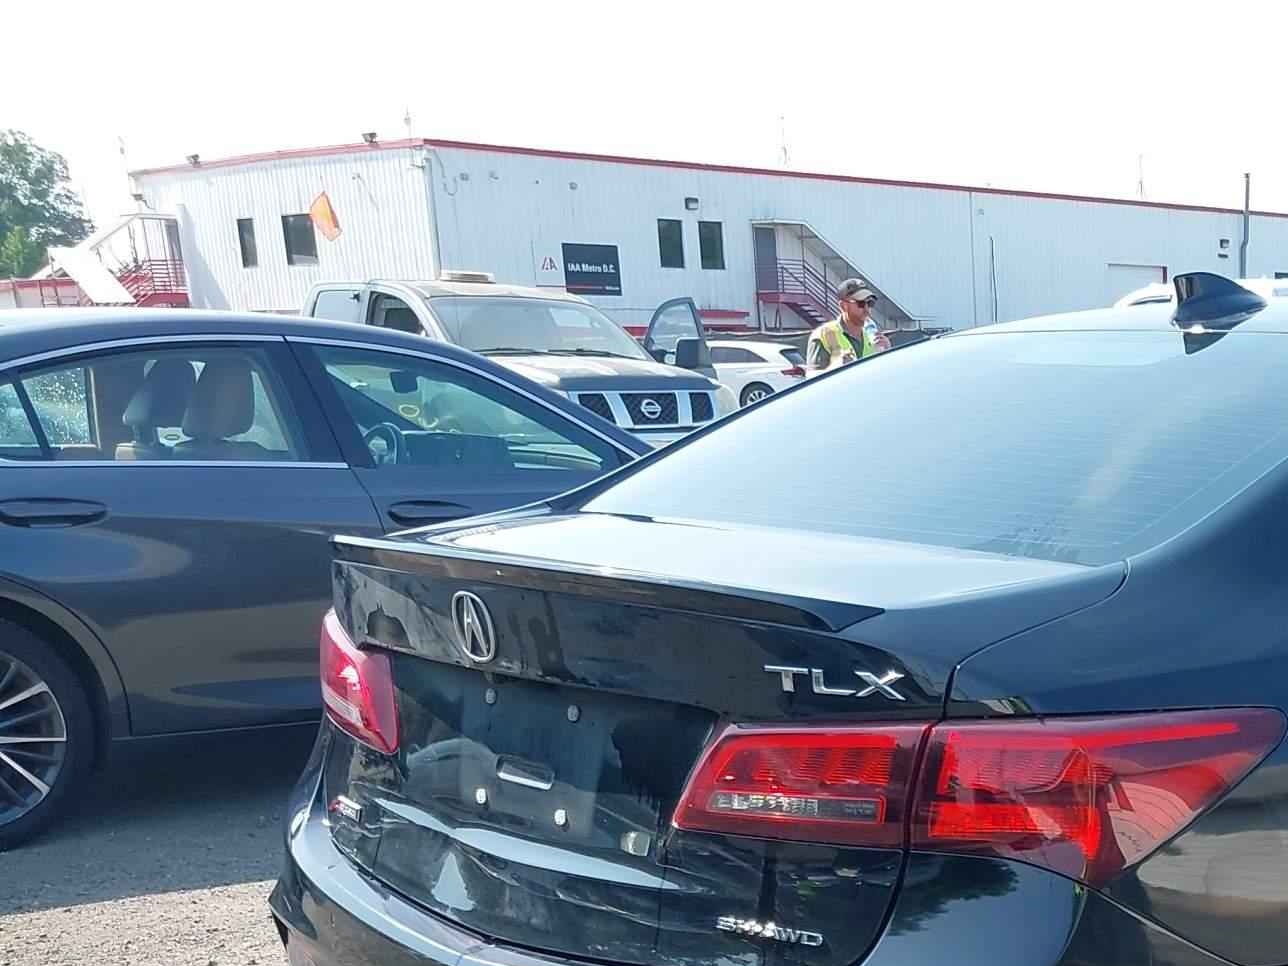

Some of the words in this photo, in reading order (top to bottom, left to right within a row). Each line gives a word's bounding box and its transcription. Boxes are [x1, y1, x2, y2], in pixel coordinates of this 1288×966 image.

[567, 262, 581, 272] IAA
[581, 263, 602, 273] Metro
[602, 264, 616, 273] D.C.
[763, 664, 907, 701] TLX
